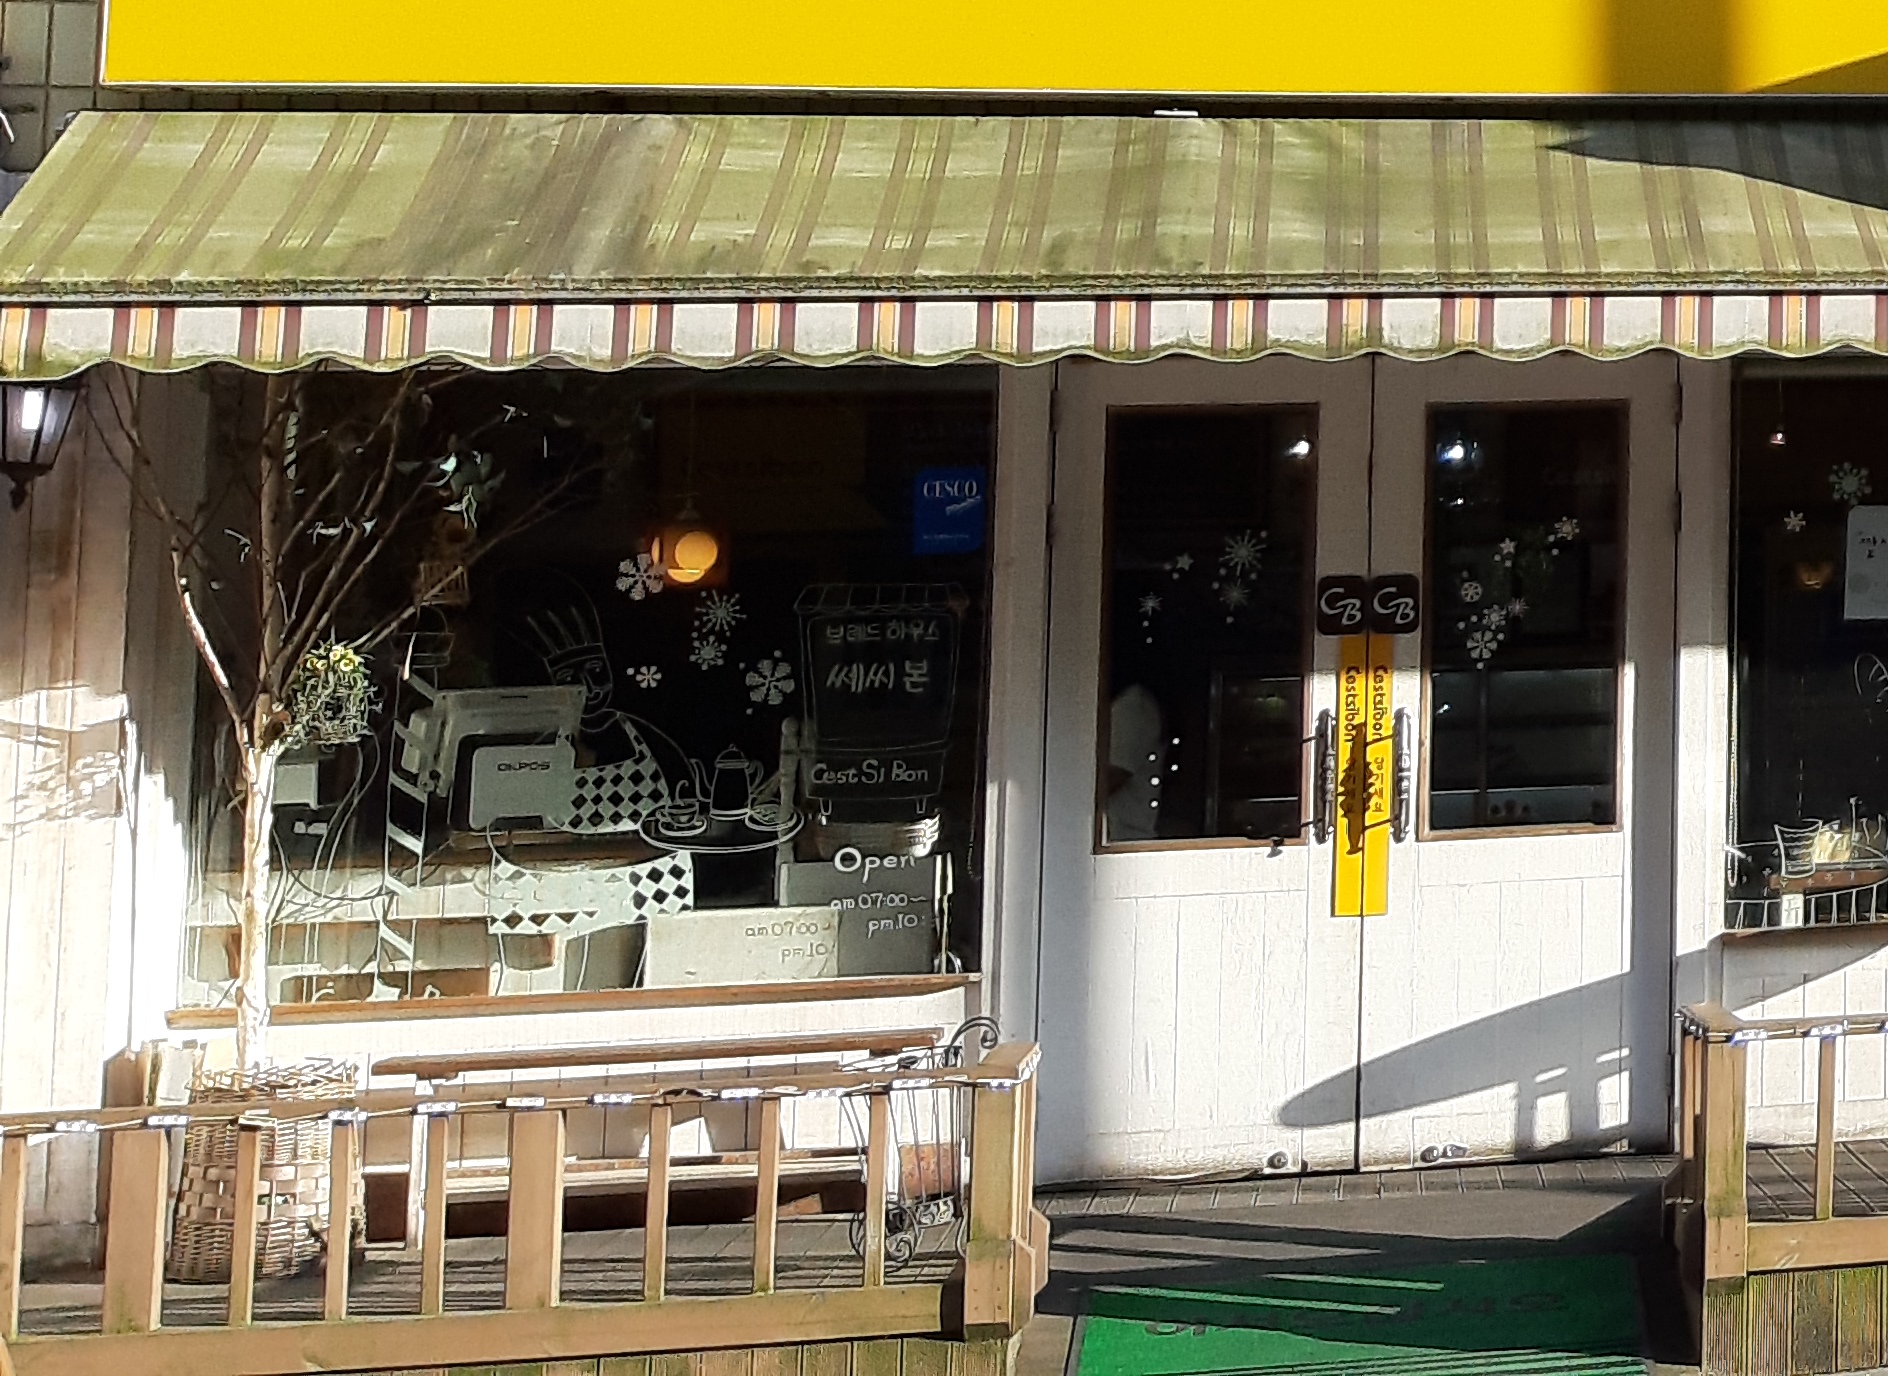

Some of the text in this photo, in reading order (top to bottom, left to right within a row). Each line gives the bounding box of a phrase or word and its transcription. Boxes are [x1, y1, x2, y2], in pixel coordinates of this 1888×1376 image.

[1320, 587, 1361, 625] CB
[1373, 586, 1415, 624] CB
[834, 847, 916, 884] Open
